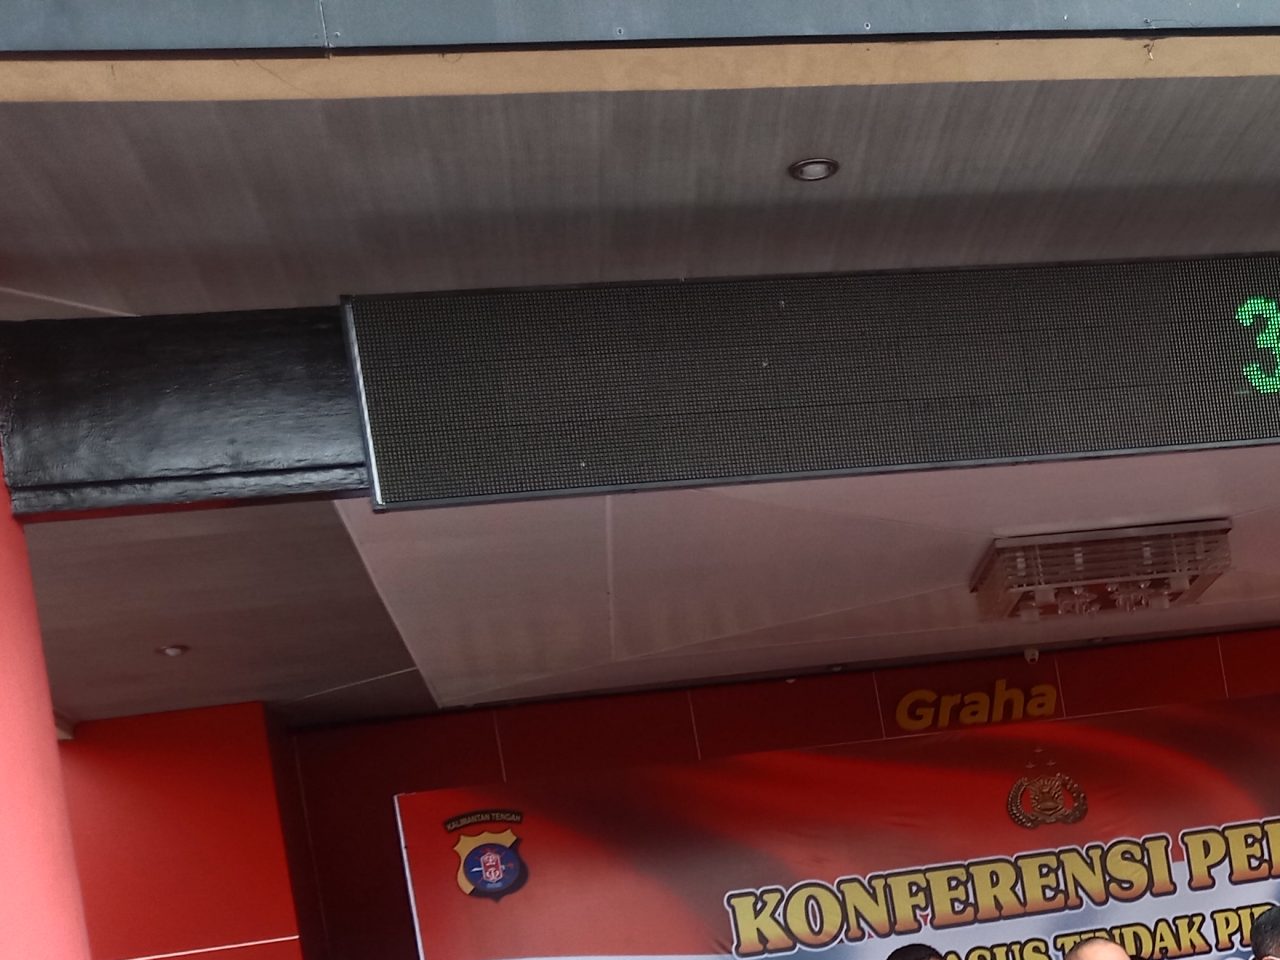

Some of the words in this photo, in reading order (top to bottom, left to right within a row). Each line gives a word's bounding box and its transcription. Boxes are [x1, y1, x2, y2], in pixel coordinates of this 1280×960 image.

[895, 679, 1057, 731] Graha
[445, 811, 491, 832] KALIMANTAN
[491, 812, 522, 822] TENGAH
[728, 836, 1172, 954] KONFERENSI
